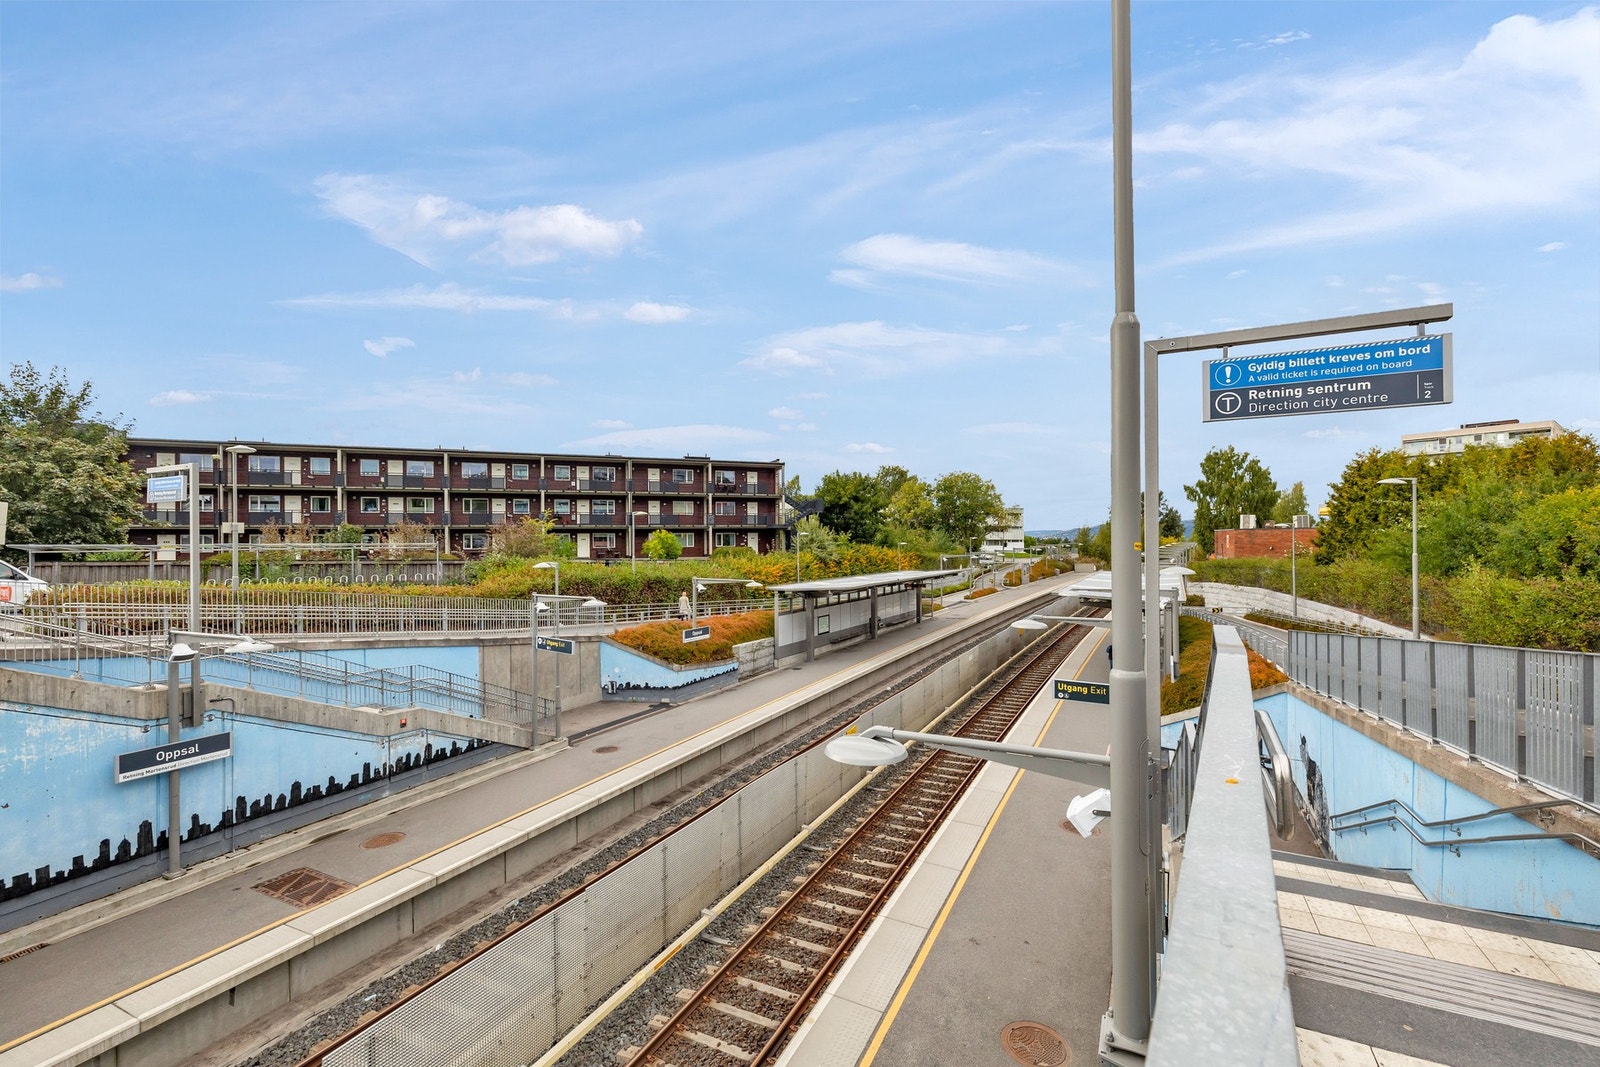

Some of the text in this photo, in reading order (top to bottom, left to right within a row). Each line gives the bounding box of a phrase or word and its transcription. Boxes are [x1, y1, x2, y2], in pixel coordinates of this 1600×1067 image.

[1248, 344, 1431, 373] Gyldig billett kreves om bord
[1257, 372, 1279, 382] valid
[1281, 370, 1308, 380] ticket
[1310, 368, 1318, 377] is
[1320, 364, 1363, 376] required
[1366, 362, 1379, 371] on
[1381, 359, 1413, 370] board
[1248, 381, 1371, 400] Retning sentrum
[1424, 390, 1432, 399] 2
[1249, 394, 1389, 413] Direction city centre
[1057, 682, 1107, 696] Utgang Exit
[156, 743, 200, 762] Oppsal
[122, 771, 145, 780] Retning
